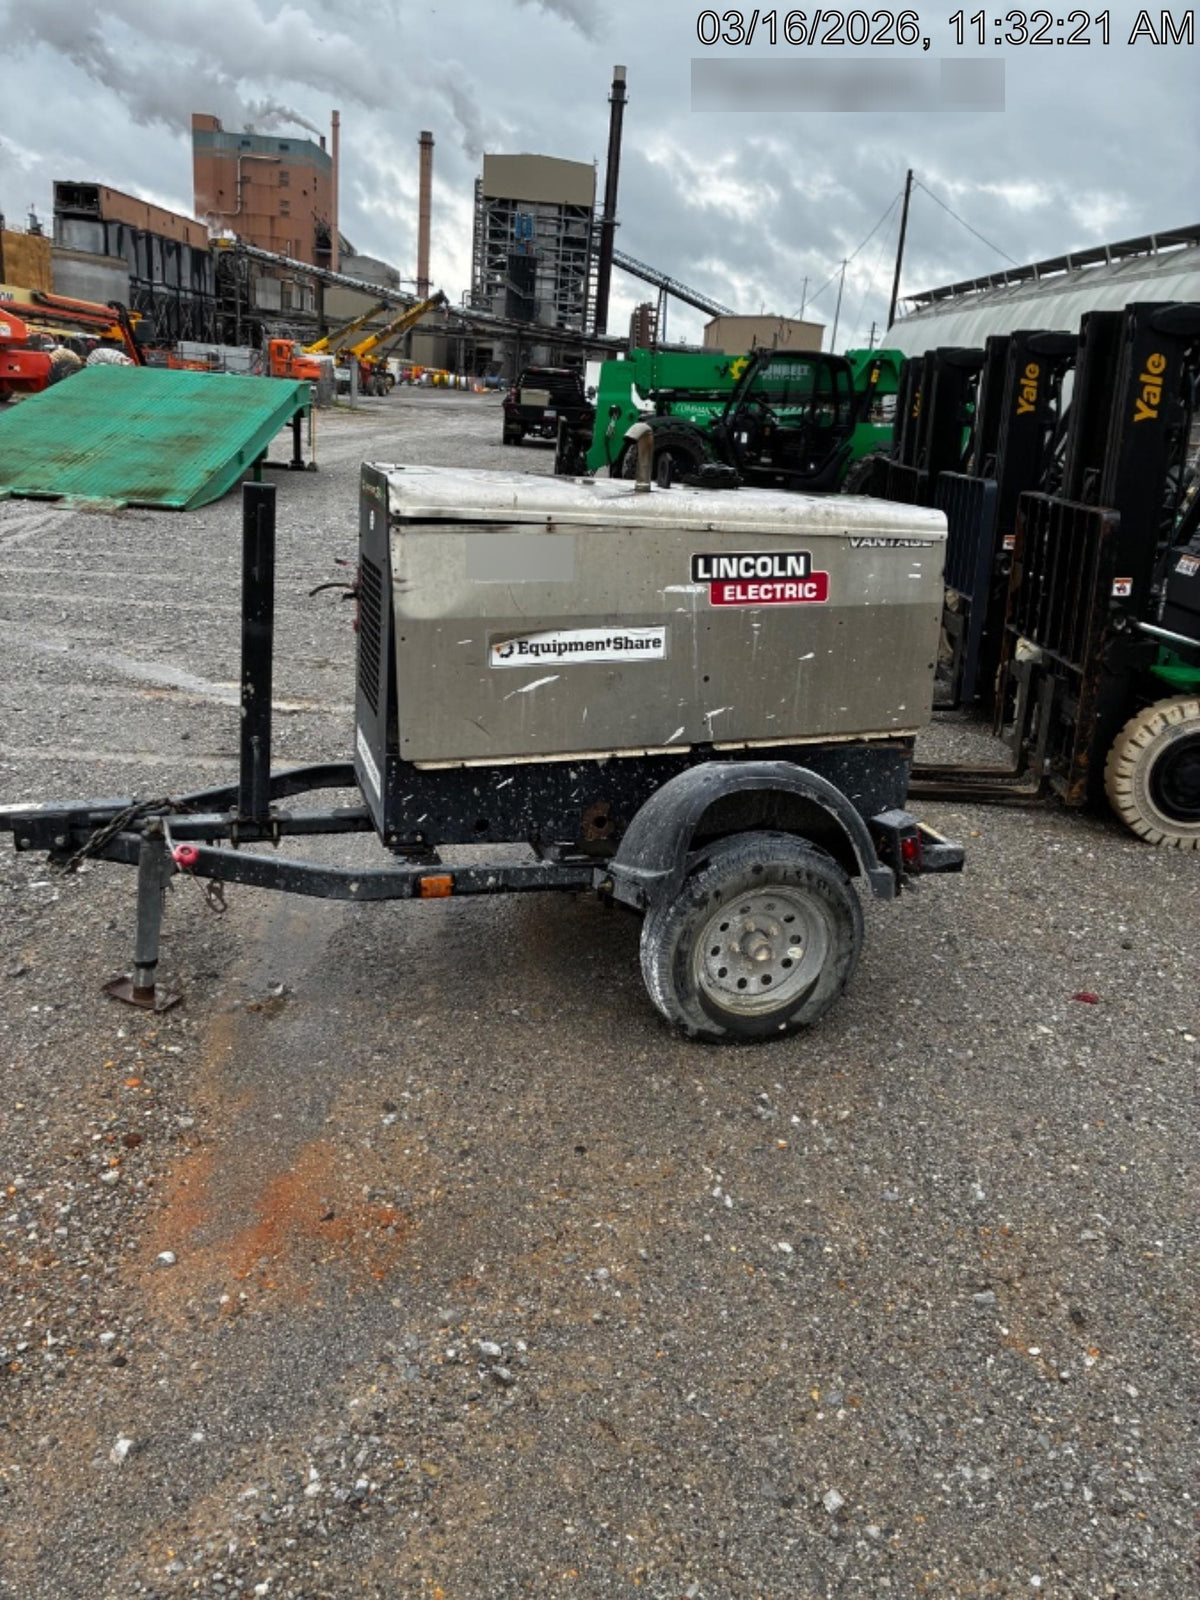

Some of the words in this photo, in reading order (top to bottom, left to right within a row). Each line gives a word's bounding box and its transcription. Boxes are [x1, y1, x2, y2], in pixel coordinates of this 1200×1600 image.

[1017, 363, 1040, 415] Yale
[1134, 353, 1167, 423] Yale
[698, 556, 805, 579] LINCOLN
[723, 583, 817, 601] ELECTRIC
[517, 637, 662, 657] EquipmentShare
